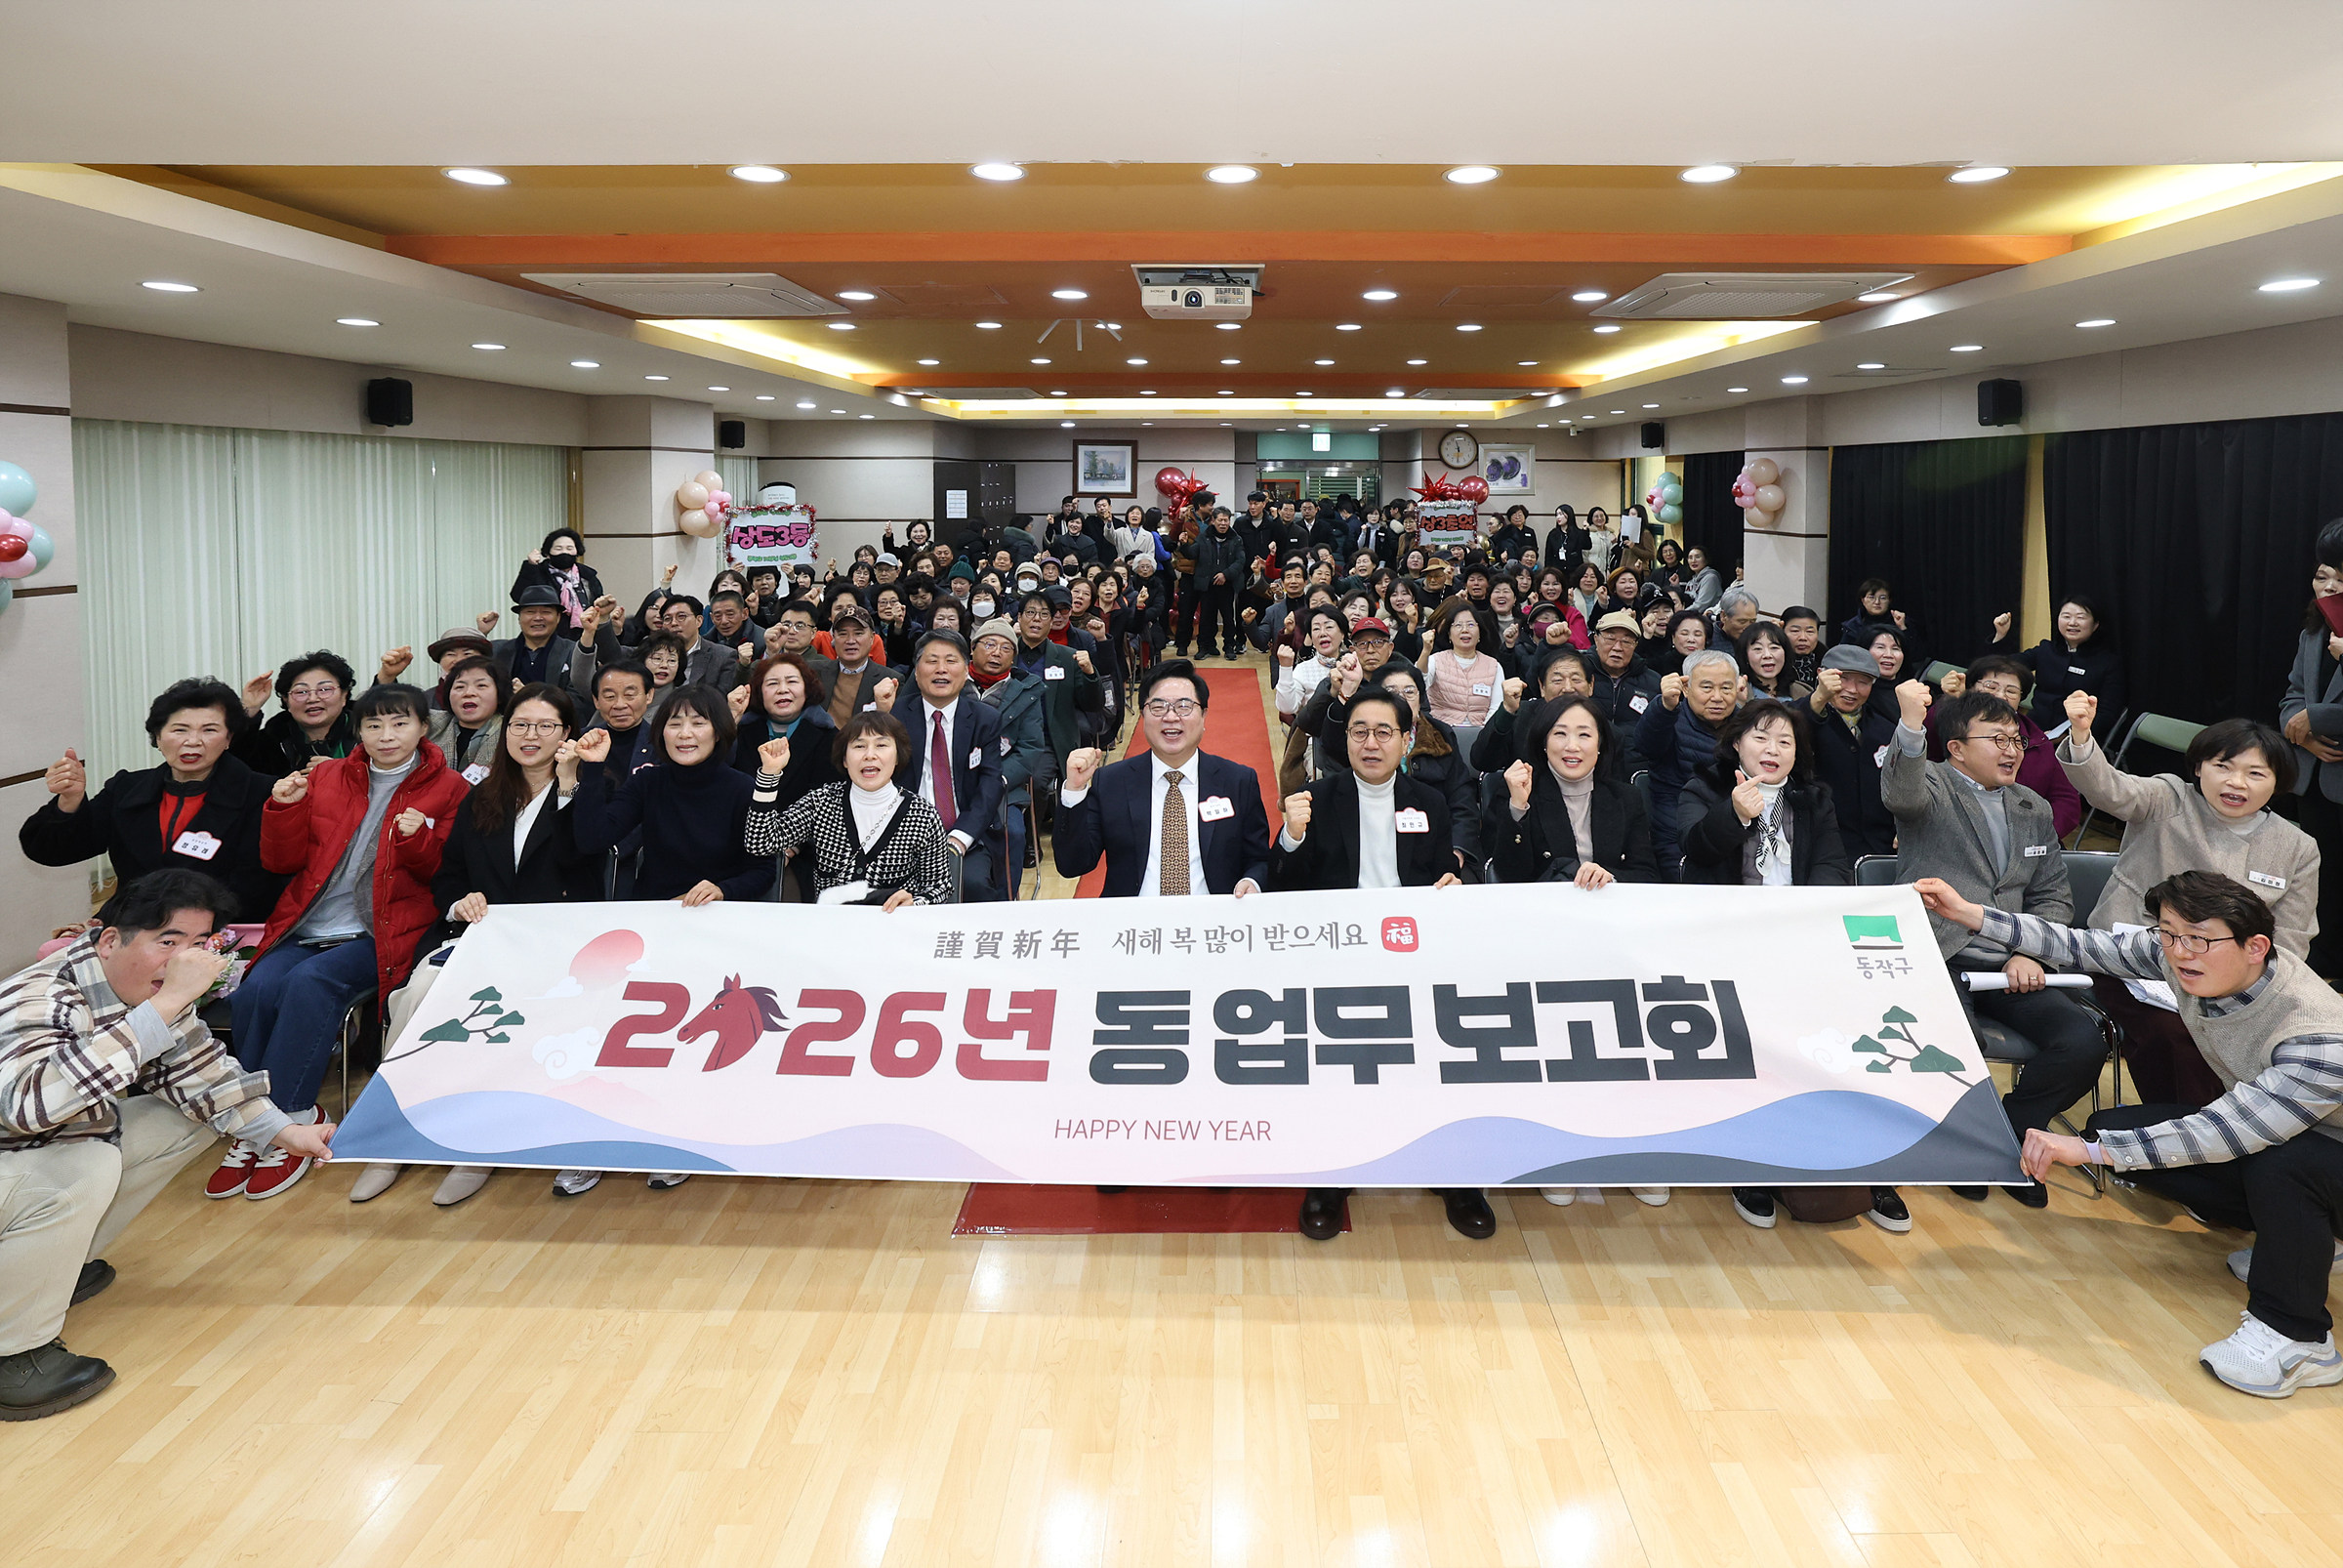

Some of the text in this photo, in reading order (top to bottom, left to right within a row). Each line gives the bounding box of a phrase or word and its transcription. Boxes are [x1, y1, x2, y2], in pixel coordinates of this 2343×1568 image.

[732, 522, 811, 549] 상도3동
[933, 928, 1081, 960] 謹賀新年
[1112, 921, 1369, 955] 새해 복 많이 받으세요
[1385, 922, 1415, 947] 福
[1856, 956, 1914, 980] 동작구
[1432, 974, 1757, 1085] 보고회
[1054, 1119, 1273, 1141] HAPPY NEW YEAR
